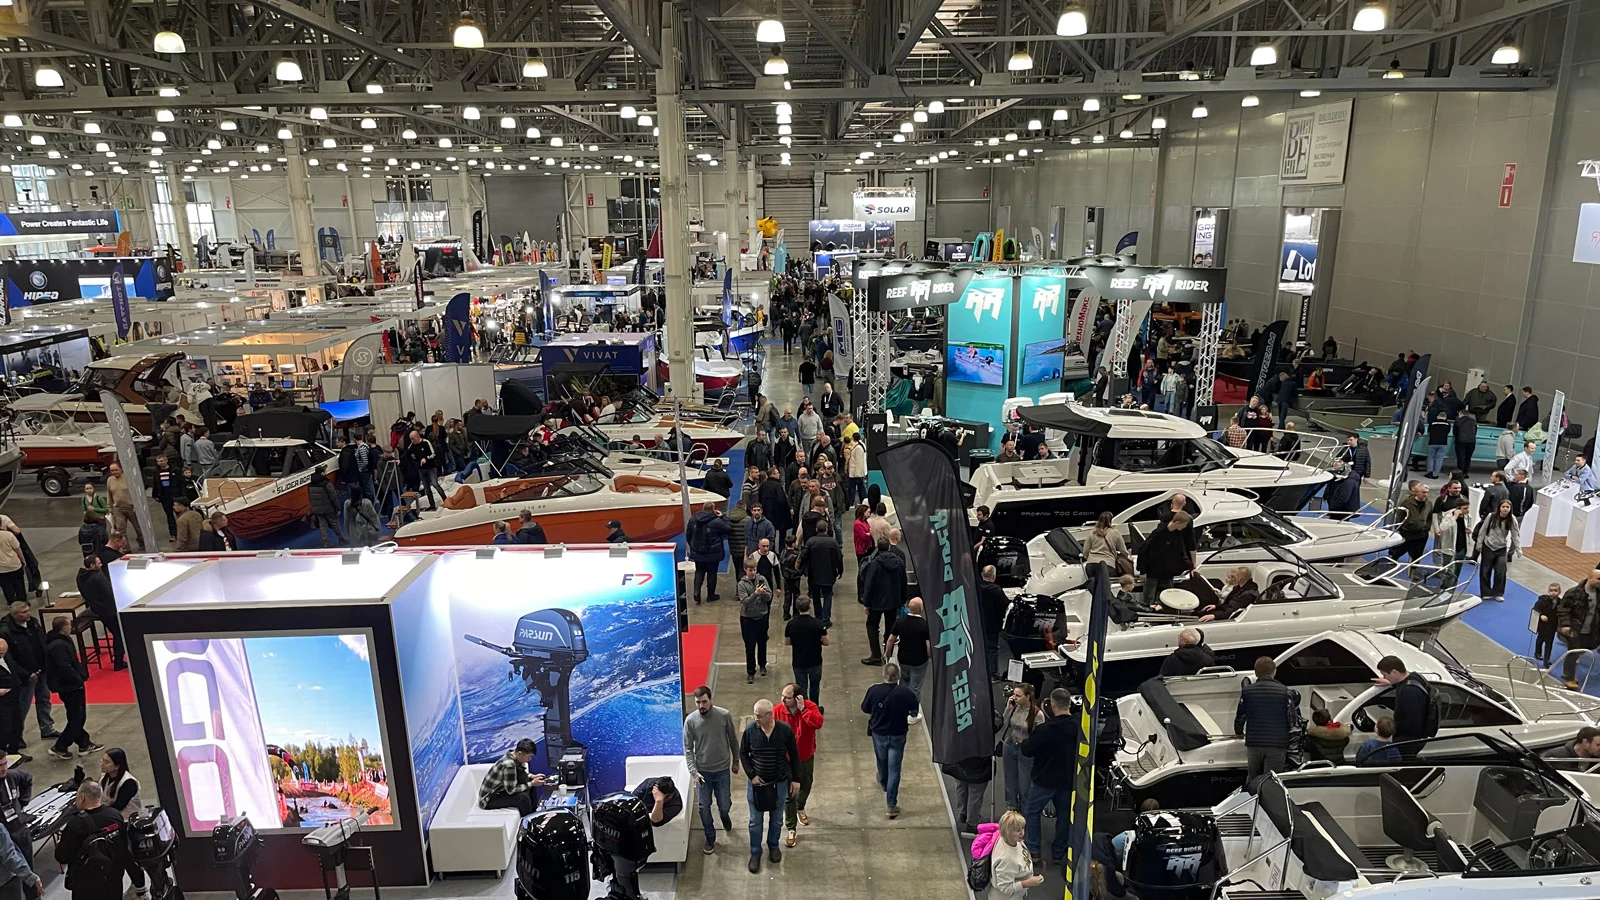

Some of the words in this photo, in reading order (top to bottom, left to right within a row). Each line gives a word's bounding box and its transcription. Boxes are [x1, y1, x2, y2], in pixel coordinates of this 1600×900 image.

[877, 206, 910, 214] SOLAR
[20, 220, 41, 228] Power
[42, 219, 67, 228] Creates
[67, 219, 96, 227] Fantastic
[96, 218, 109, 226] Life
[886, 286, 908, 299] REEF
[932, 282, 955, 294] RIDER
[1110, 278, 1139, 289] REEF
[1175, 279, 1209, 293] RIDER
[1076, 296, 1090, 344] ехноМакс
[583, 351, 619, 360] VIVAT
[276, 479, 299, 495] SLIDER
[621, 573, 653, 586] F7
[518, 628, 554, 641] PARSUN
[564, 872, 581, 884] 115
